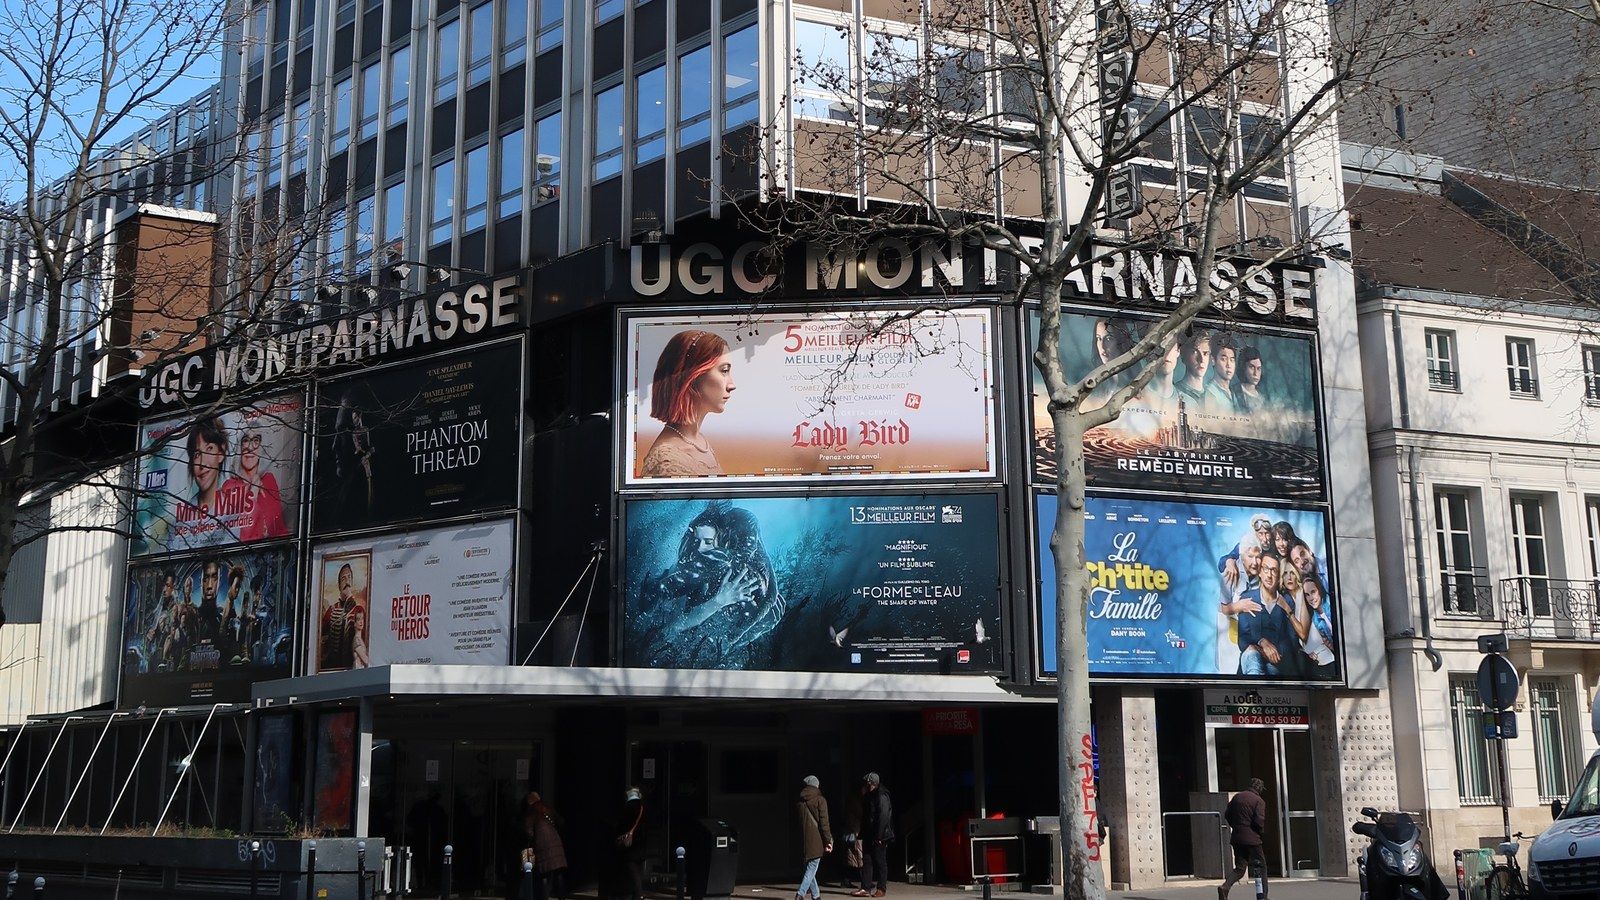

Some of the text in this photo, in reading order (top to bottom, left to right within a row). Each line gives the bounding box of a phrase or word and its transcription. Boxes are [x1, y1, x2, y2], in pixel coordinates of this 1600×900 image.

[630, 242, 777, 296] UGC
[139, 275, 520, 408] UGC MONTPARNASSE
[784, 324, 803, 353] 5
[879, 330, 914, 345] FILM
[784, 354, 842, 365] MEILLEUR
[406, 420, 488, 453] PHANTOM
[791, 418, 910, 452] Lady Bird
[412, 445, 481, 475] THREAD
[819, 453, 841, 461] Prenez
[1158, 450, 1234, 462] LABYRINTHE
[1117, 457, 1185, 475] REMÈDE
[1188, 466, 1253, 479] MORTEL
[175, 485, 255, 523] Mme Mills
[850, 506, 866, 522] 13
[867, 513, 912, 522] MEILLEUR
[914, 512, 936, 521] FILM
[1108, 532, 1138, 563] La
[404, 583, 410, 595] LE
[863, 586, 912, 598] FORME
[924, 586, 962, 597] L'EAU
[391, 594, 431, 619] RETOUR
[1089, 586, 1163, 620] Famille
[391, 619, 398, 631] DU
[1224, 695, 1231, 704] A
[1233, 695, 1263, 704] LOUER
[1237, 706, 1249, 715] 07
[1251, 706, 1263, 715] 62
[1265, 706, 1276, 715] 66
[1278, 706, 1289, 715] 89
[1290, 706, 1301, 715] 91
[1238, 715, 1250, 724] 06
[1252, 715, 1263, 724] 74
[1264, 715, 1276, 724] 05
[1277, 715, 1289, 724] 50
[1290, 715, 1301, 724] 87
